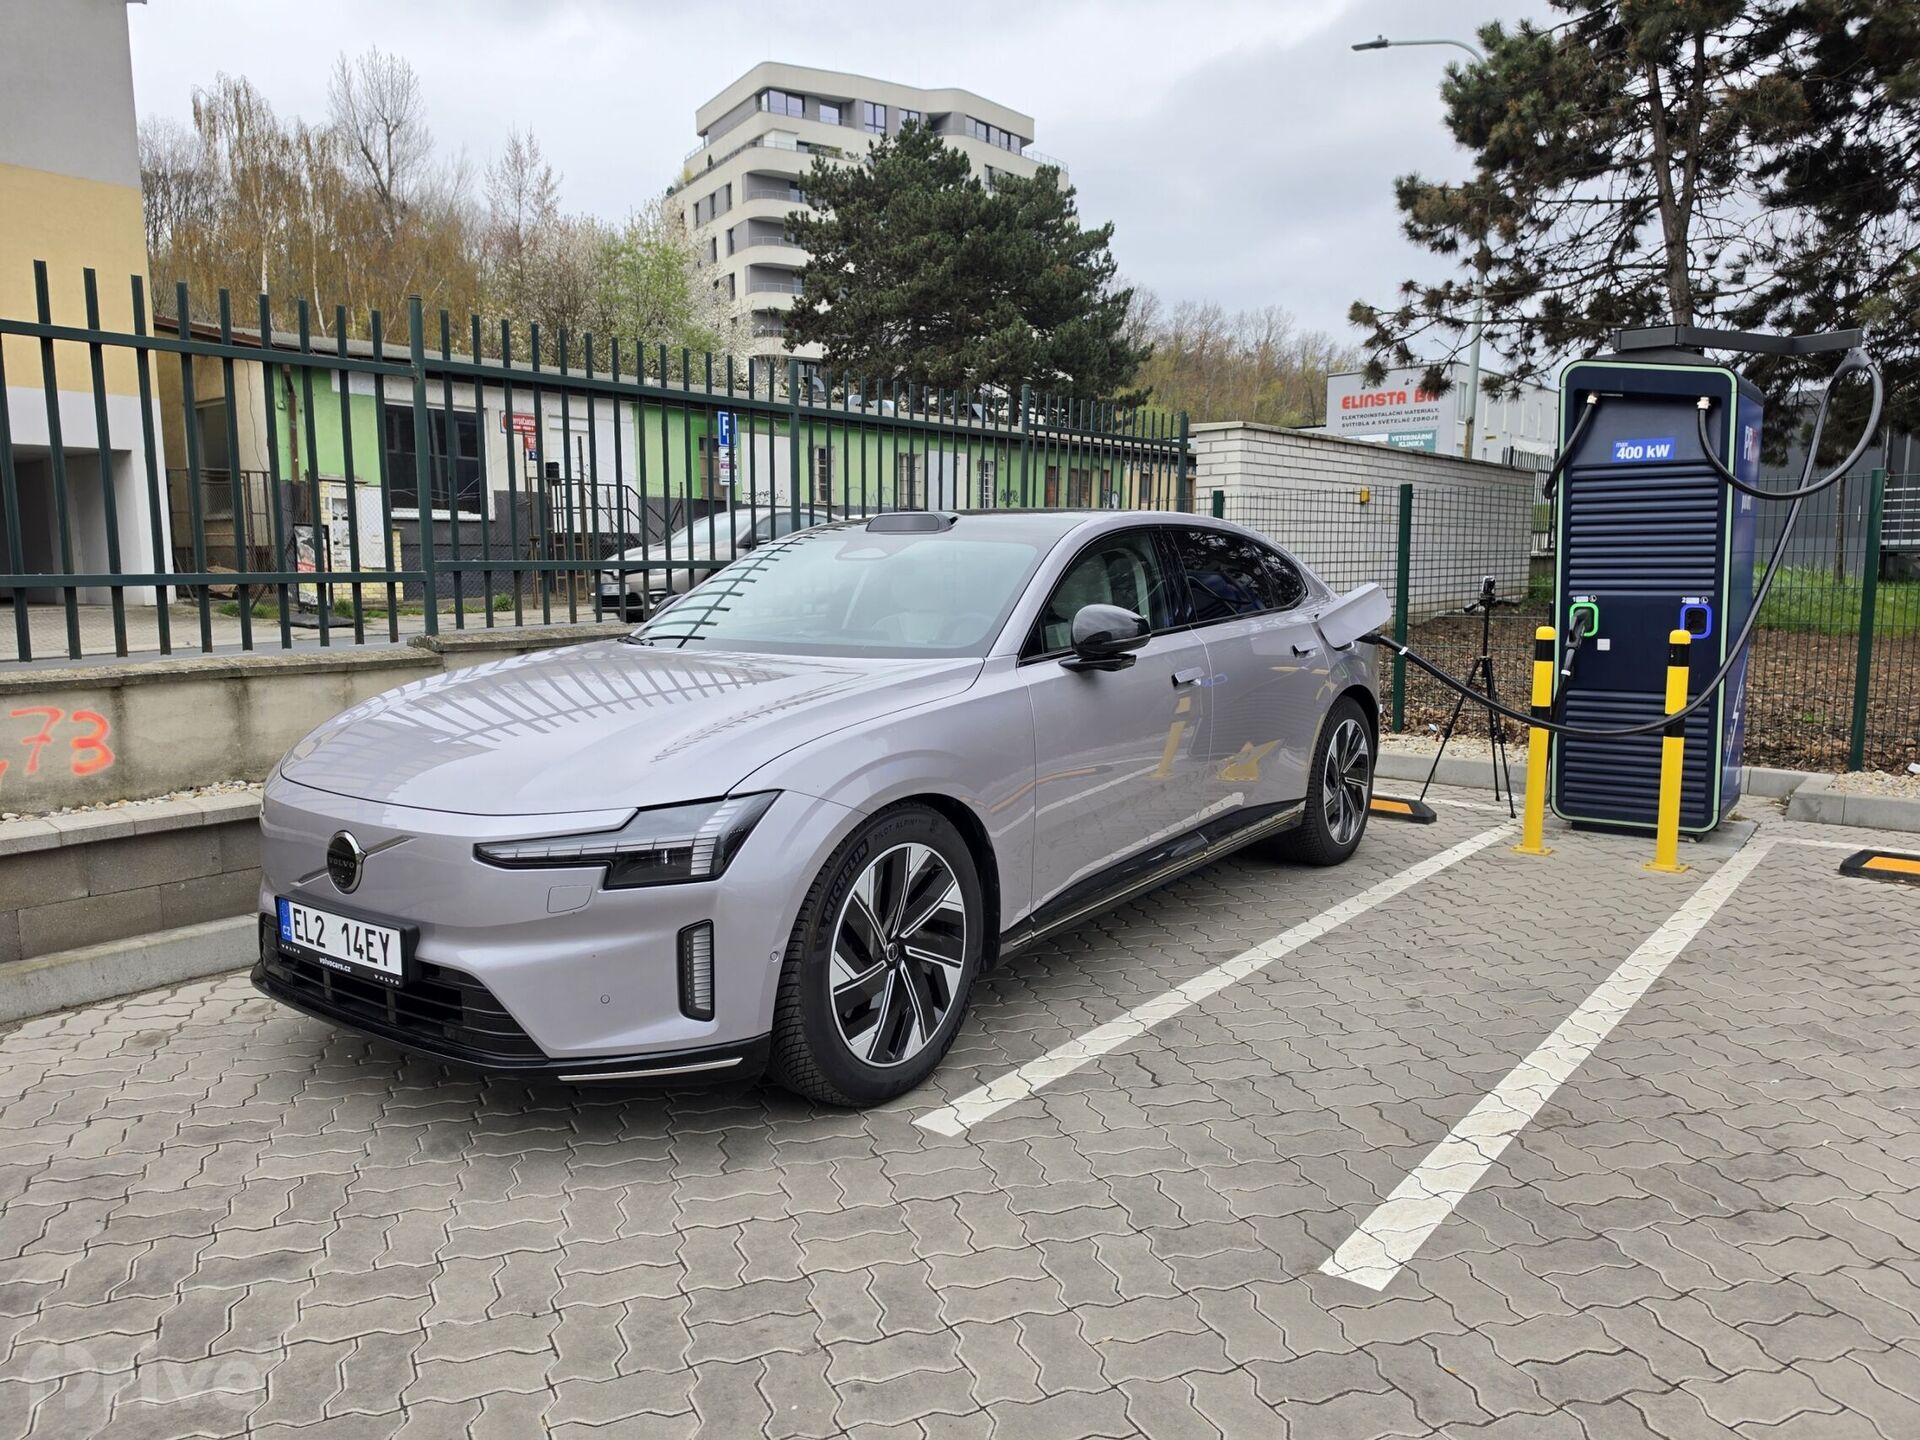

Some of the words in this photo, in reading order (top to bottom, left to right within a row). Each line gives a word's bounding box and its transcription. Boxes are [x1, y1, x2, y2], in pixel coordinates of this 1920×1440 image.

[1342, 391, 1407, 409] ELINSTA
[1398, 440, 1424, 448] KLINIKA
[1616, 446, 1643, 459] 400
[1646, 444, 1671, 458] kW
[822, 841, 868, 921] MICHELIN
[282, 925, 291, 936] CZ
[293, 907, 326, 949] EL2
[341, 922, 390, 967] 14EY
[281, 943, 301, 955] VOLVO
[319, 957, 352, 973] volvocars.cz
[373, 974, 400, 985] VOLVO
